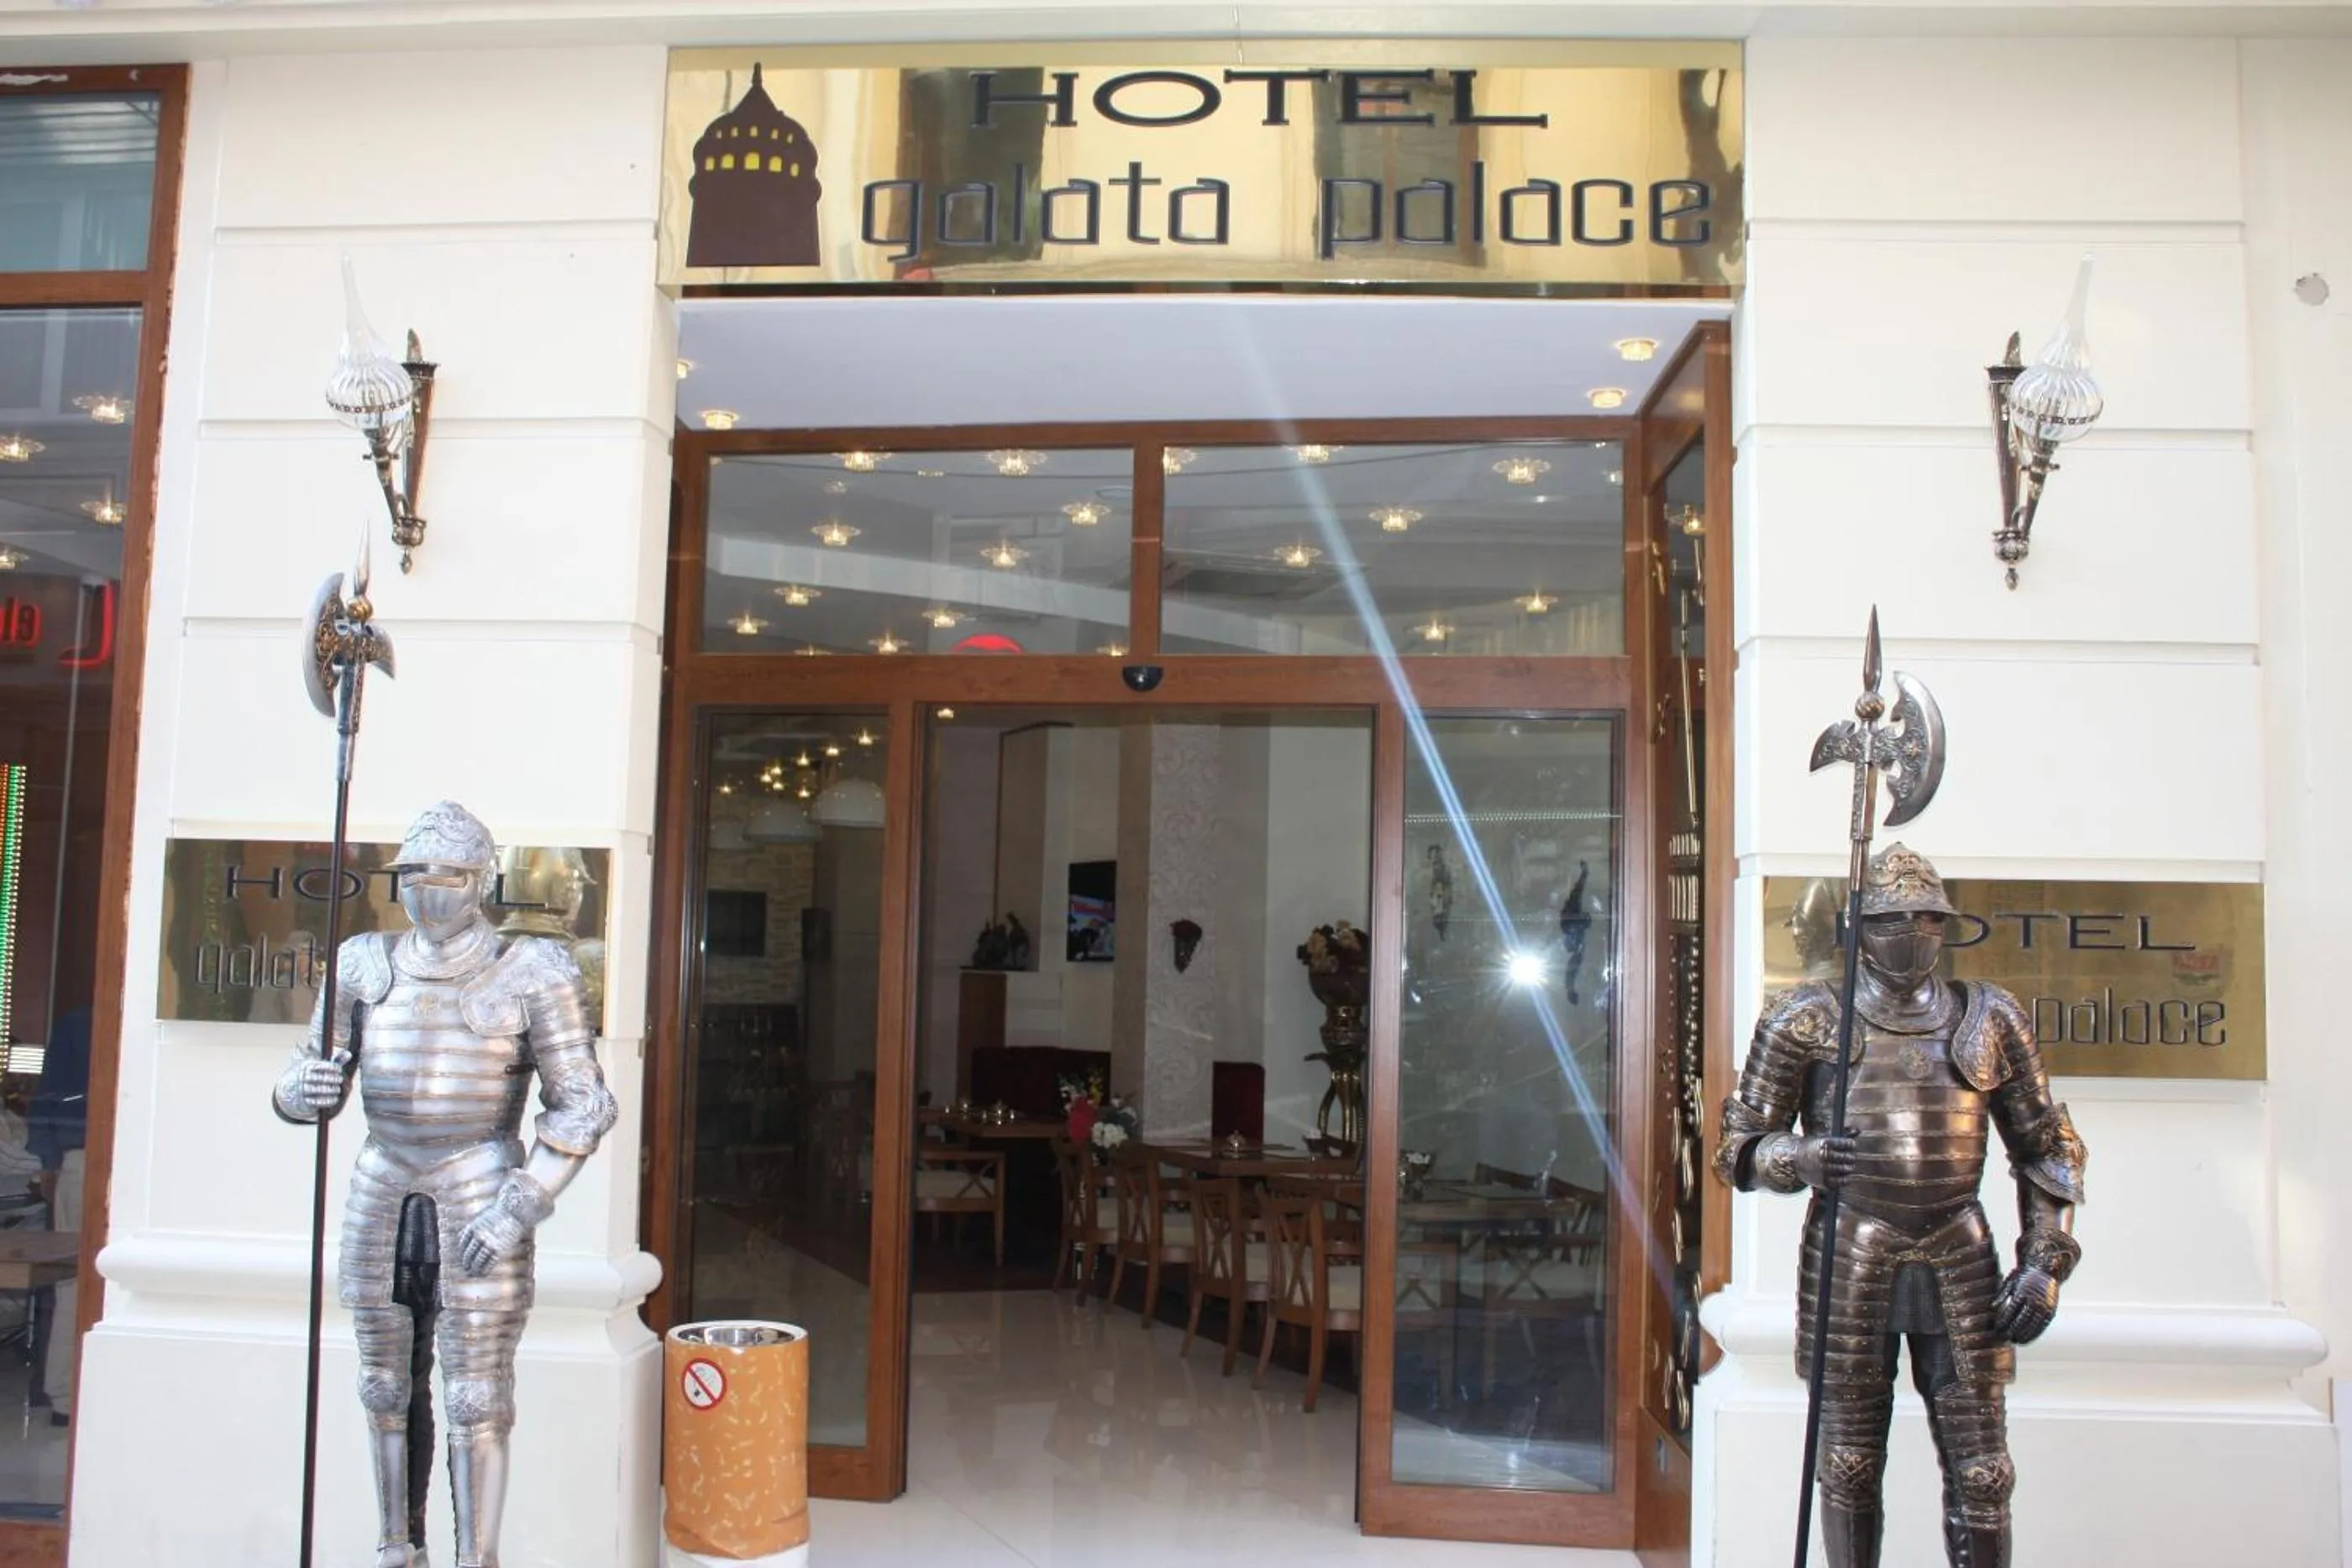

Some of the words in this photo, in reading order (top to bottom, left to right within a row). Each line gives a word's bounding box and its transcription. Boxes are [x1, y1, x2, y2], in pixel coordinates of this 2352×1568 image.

[969, 69, 1548, 128] HOTEL
[861, 161, 1231, 263] galata
[1320, 160, 1710, 261] palace
[225, 866, 548, 911] HOTL
[1835, 911, 2196, 952] OTEL
[2031, 987, 2226, 1047] palace
